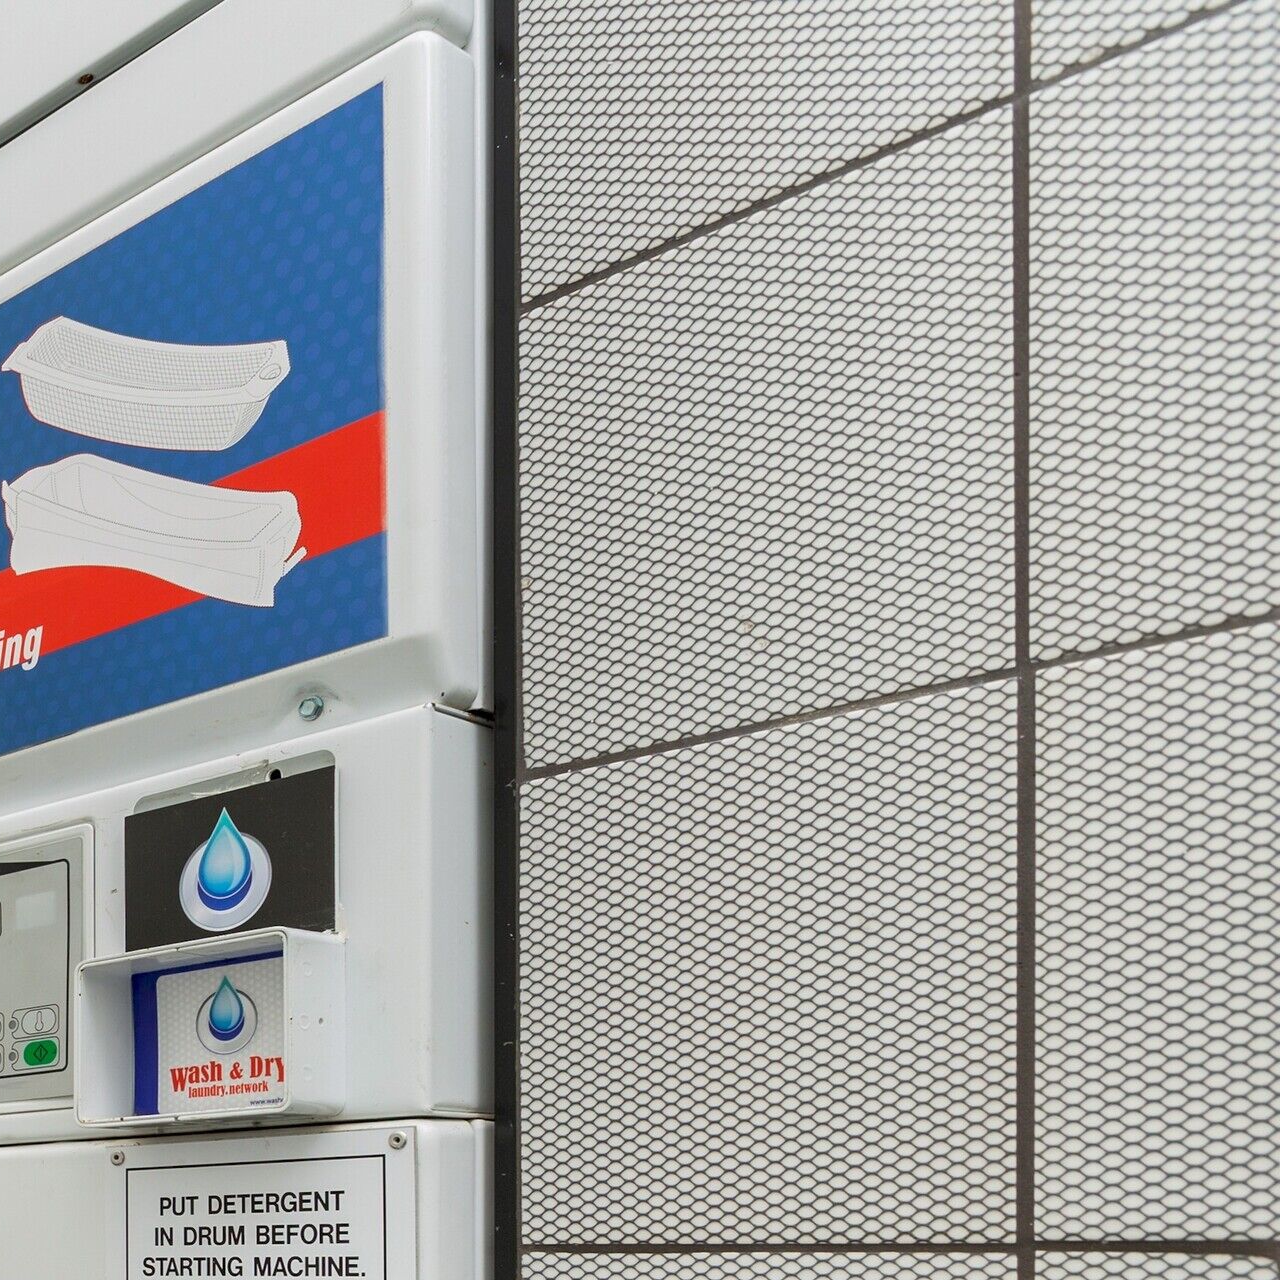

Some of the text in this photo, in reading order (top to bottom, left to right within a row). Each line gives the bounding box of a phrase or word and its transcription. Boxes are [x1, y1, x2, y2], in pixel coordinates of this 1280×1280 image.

[170, 1061, 222, 1092] Wash
[229, 1062, 243, 1080] &
[188, 1080, 269, 1099] laundry.network
[159, 1190, 345, 1216] PUT DETERGENT
[154, 1223, 350, 1246] IN DRUM BEFORE
[142, 1256, 366, 1277] STARTING MACHINE.
